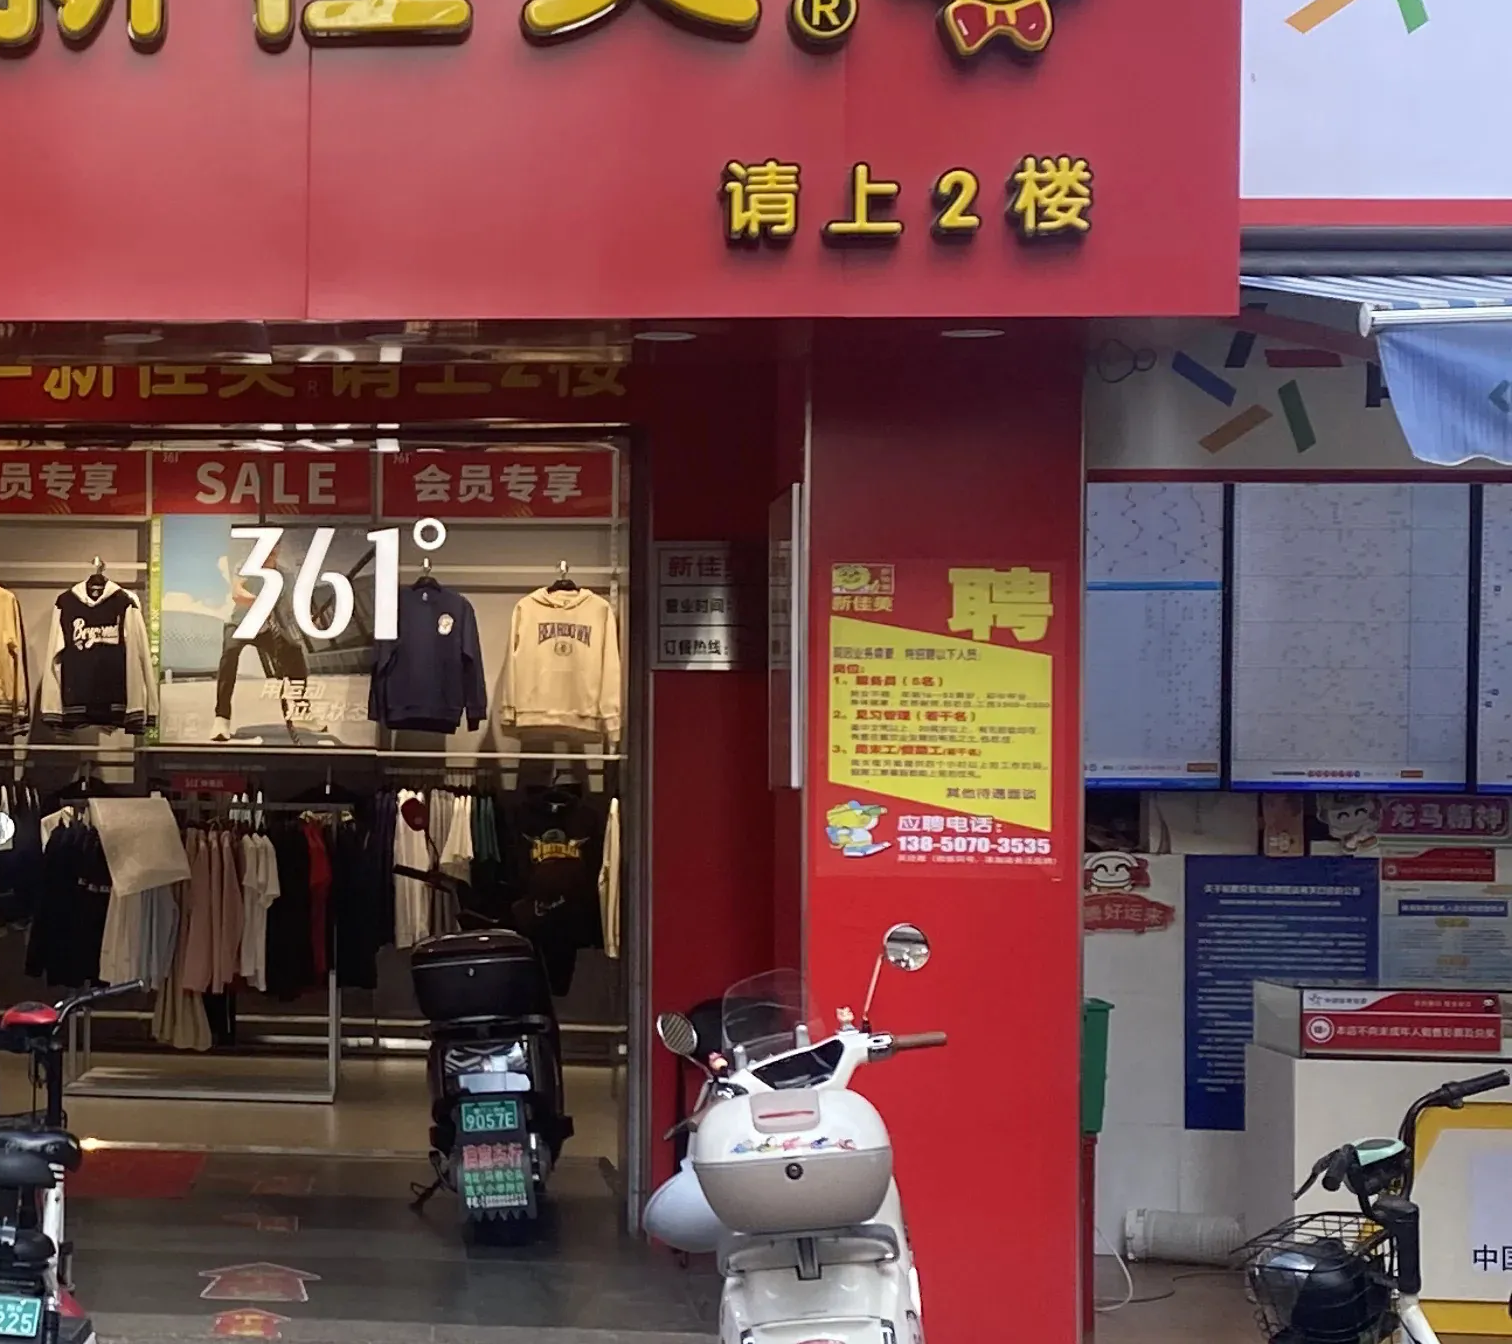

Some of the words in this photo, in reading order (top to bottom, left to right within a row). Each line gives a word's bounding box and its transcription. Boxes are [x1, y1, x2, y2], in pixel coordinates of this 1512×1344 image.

[724, 154, 1094, 240] 请上2楼
[195, 461, 338, 506] SALE
[412, 463, 583, 505] 会员专享
[230, 517, 447, 641] 361°
[947, 566, 1054, 643] 聘
[465, 1112, 516, 1129] 9057E
